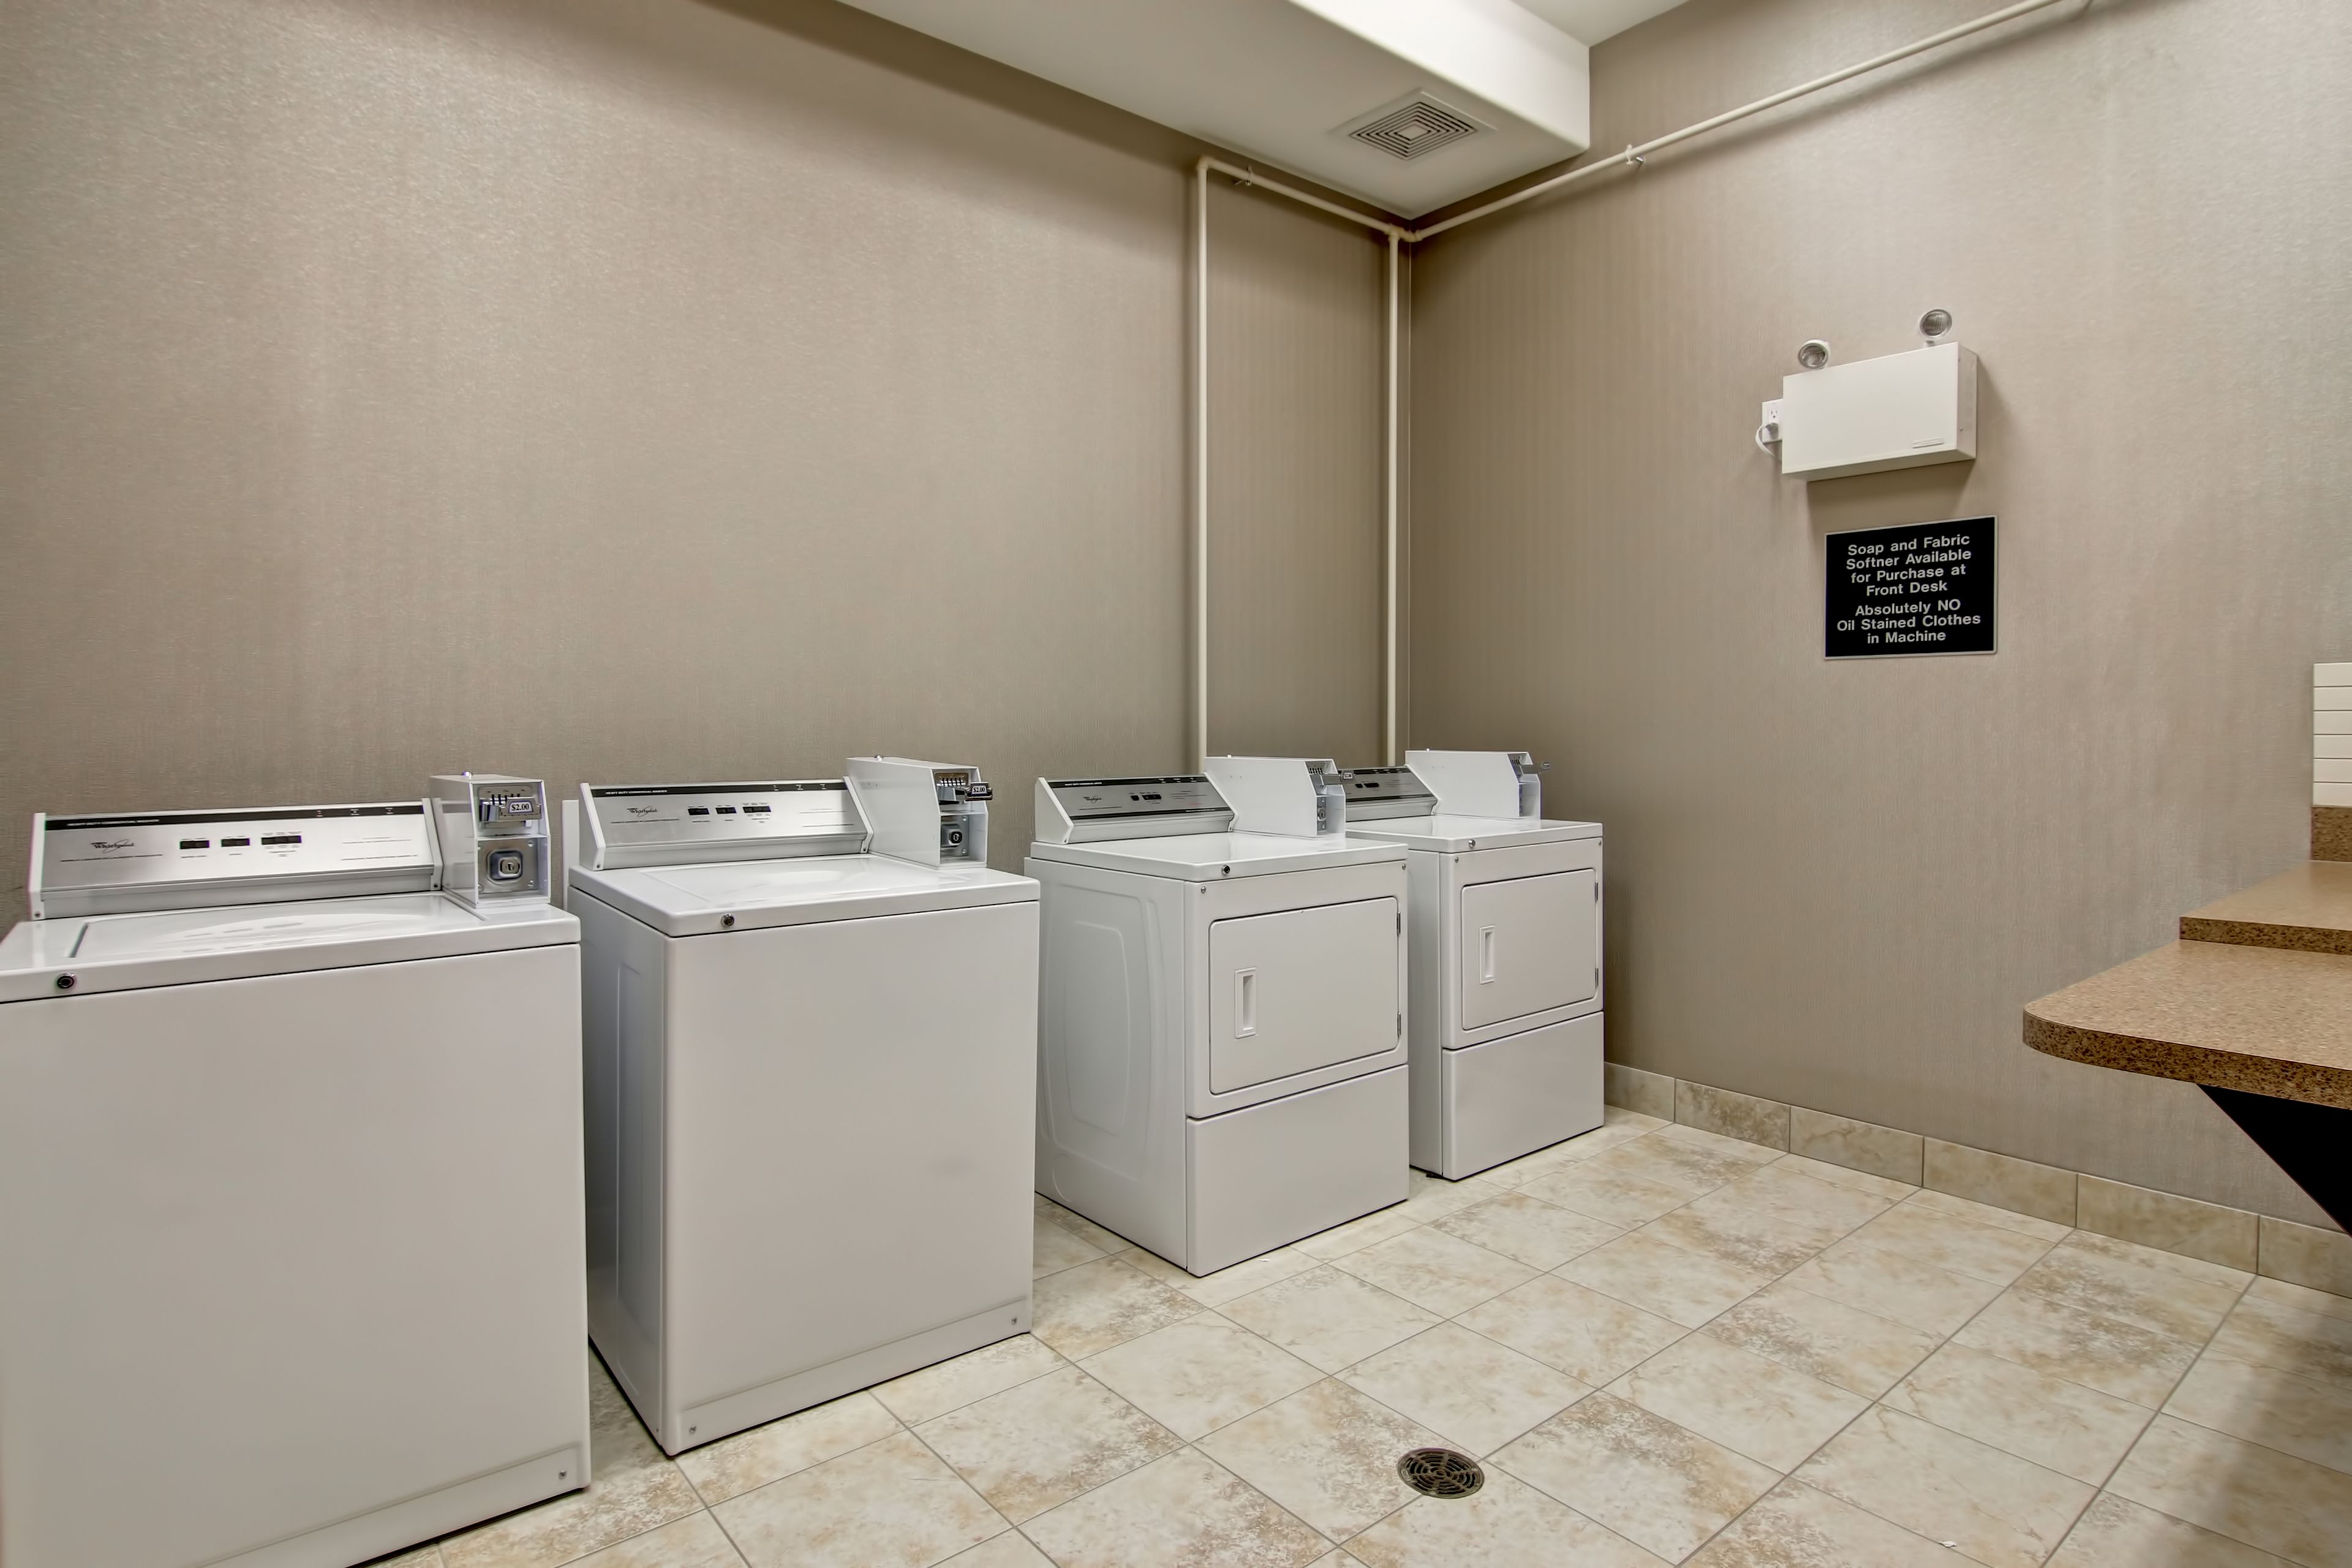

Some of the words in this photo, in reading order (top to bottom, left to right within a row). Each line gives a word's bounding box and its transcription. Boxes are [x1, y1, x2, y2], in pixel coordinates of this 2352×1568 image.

[1848, 544, 1884, 556] Soap
[1890, 538, 1917, 552] and
[1924, 534, 1970, 548] Fabric
[1846, 557, 1899, 570] Softner
[1905, 549, 1972, 565] Available
[1851, 572, 1871, 583] for
[1877, 568, 1944, 581] Purchase
[1951, 564, 1967, 575] at
[1866, 584, 1904, 596] Front
[1910, 580, 1948, 593] Desk
[1855, 601, 1931, 616] Absolutely
[1937, 598, 1961, 611] NO
[1837, 620, 1855, 631] Oil
[1861, 616, 1916, 630] Stained
[1922, 614, 1981, 627] Clothes
[1868, 633, 1880, 644] in
[1885, 630, 1947, 643] Machine
